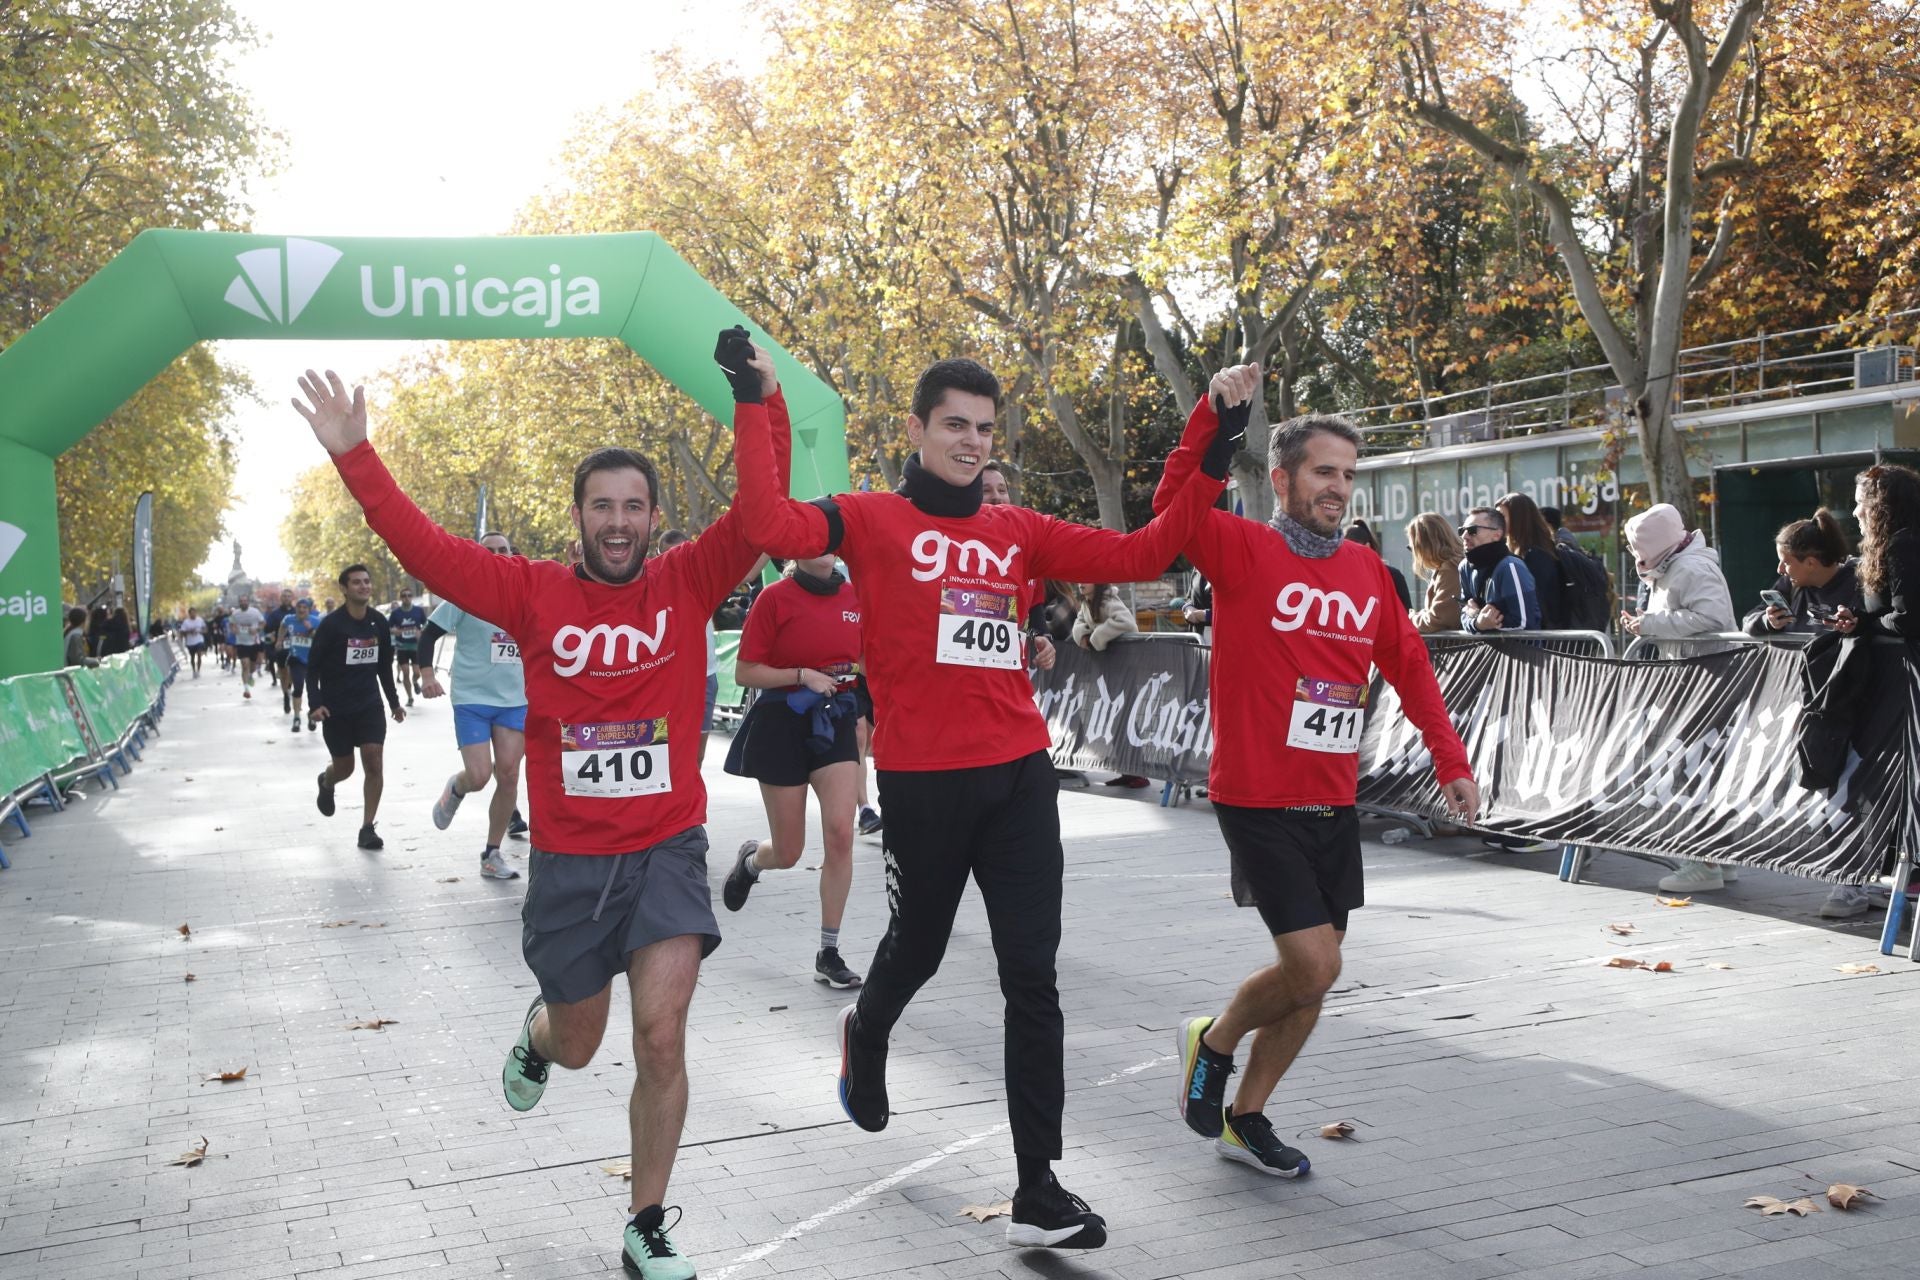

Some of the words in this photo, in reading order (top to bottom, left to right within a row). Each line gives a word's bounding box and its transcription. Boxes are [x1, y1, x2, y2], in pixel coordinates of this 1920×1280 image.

[360, 264, 600, 328] Unicaja
[1420, 471, 1509, 519] ciudad
[1522, 463, 1620, 515] amiga
[911, 530, 1018, 582] gmv
[1271, 582, 1376, 632] gmv
[352, 648, 375, 660] 289
[552, 609, 668, 678] gmv
[952, 620, 1011, 653] 409
[589, 666, 640, 678] INNOVATING
[596, 724, 625, 733] CARRERA
[626, 723, 636, 732] DE
[1086, 674, 1126, 745] de
[1303, 708, 1356, 739] 411
[596, 730, 636, 741] EMPRESAS
[577, 750, 653, 784] 410
[1189, 1056, 1209, 1099] HOKA
